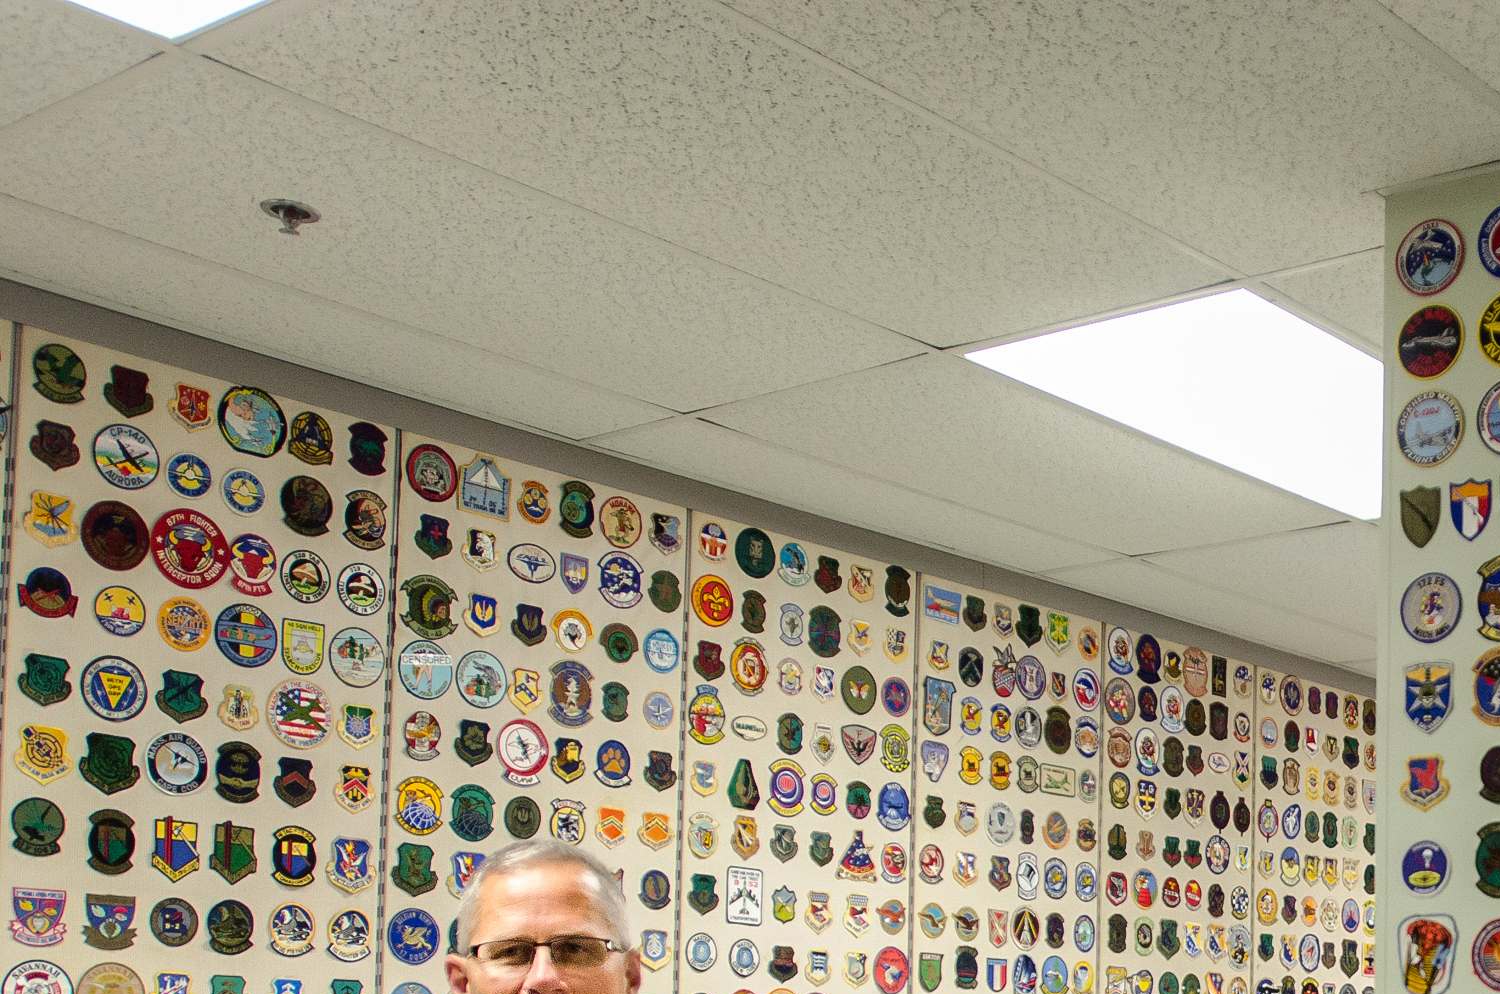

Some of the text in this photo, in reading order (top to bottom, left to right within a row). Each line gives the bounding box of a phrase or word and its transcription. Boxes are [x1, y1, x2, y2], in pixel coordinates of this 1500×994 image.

[1400, 392, 1435, 432] LOCKHEED
[110, 427, 146, 445] CP-140
[1403, 446, 1435, 463] FLIGHT
[105, 470, 144, 486] AURORA
[609, 500, 635, 515] MOHAWK
[166, 513, 218, 538] 87TH FIGHTER
[156, 550, 202, 584] INTERCEPTOR
[252, 584, 267, 593] FTS
[402, 654, 451, 665] CENSORED
[280, 685, 289, 694] IN
[305, 683, 323, 698] GOOD
[284, 733, 297, 745] FOR
[184, 737, 207, 764] GUARD
[156, 778, 199, 793] CAPE COD
[12, 963, 61, 980] SAVANNAH
